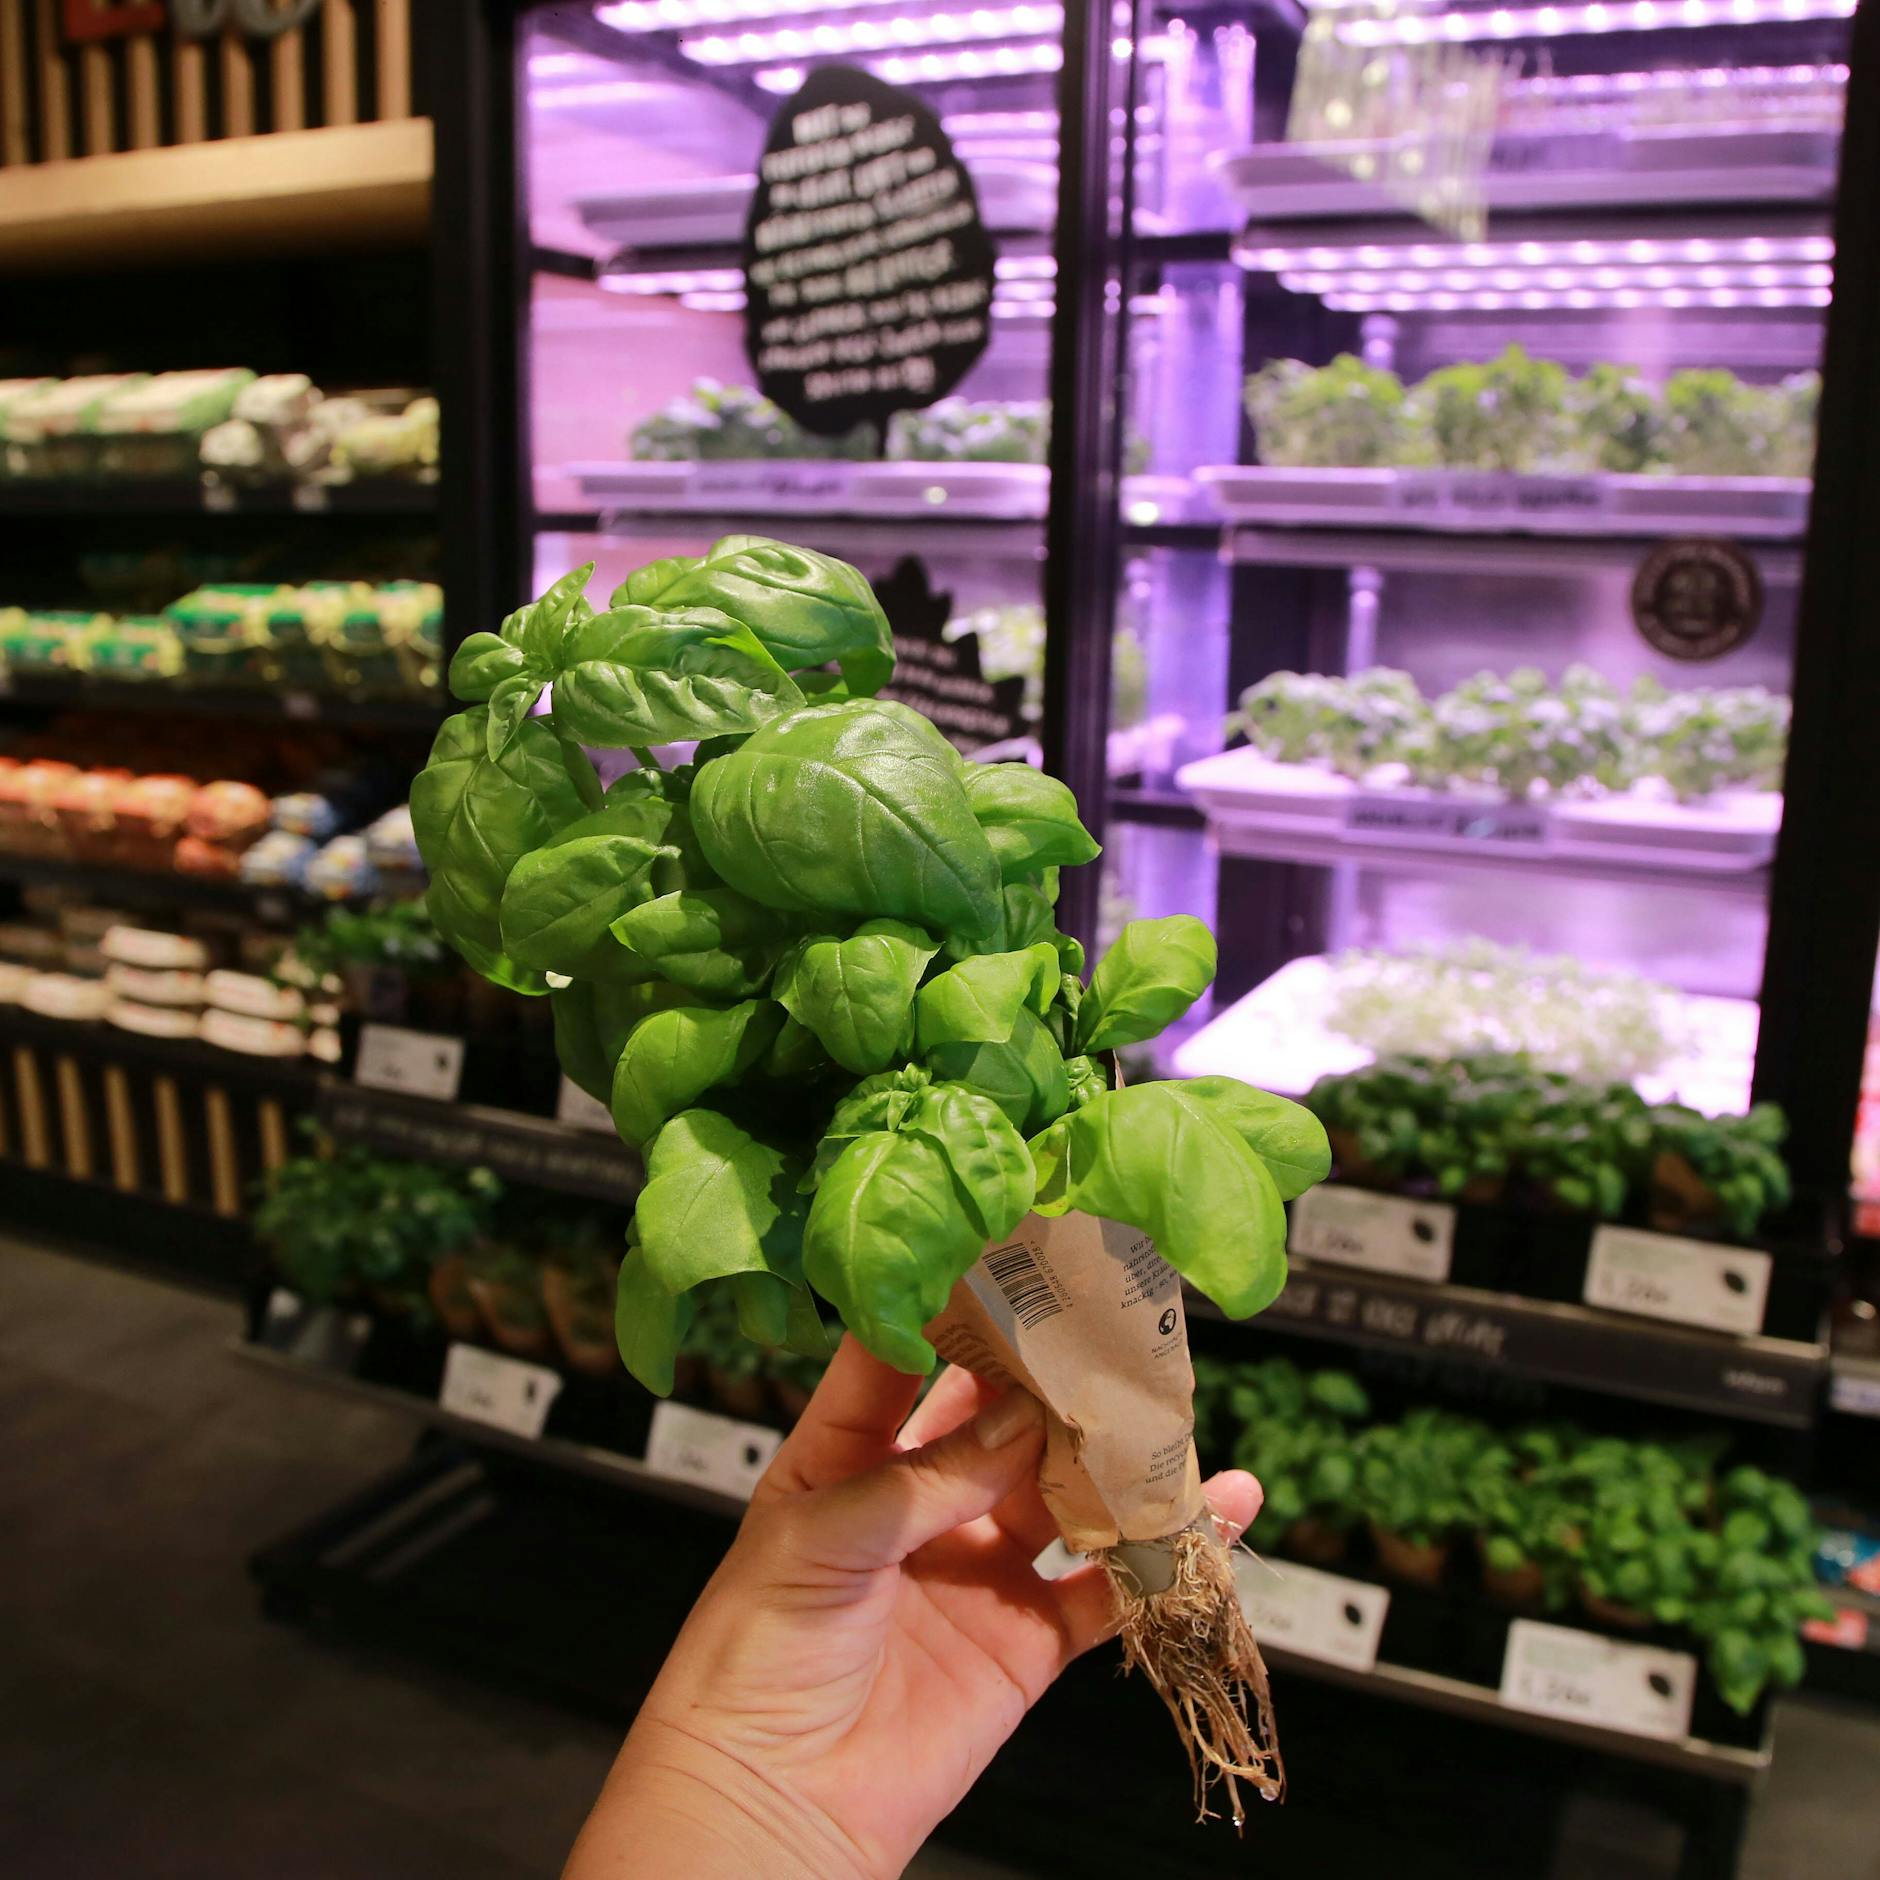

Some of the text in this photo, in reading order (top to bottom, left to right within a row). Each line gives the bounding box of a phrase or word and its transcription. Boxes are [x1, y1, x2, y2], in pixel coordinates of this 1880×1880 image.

[1124, 1276, 1152, 1296] unsere
[1120, 1287, 1154, 1309] knackig
[1152, 1451, 1161, 1460] So
[1145, 1471, 1163, 1484] und
[1165, 1467, 1177, 1477] die
[1150, 1462, 1164, 1472] Die
